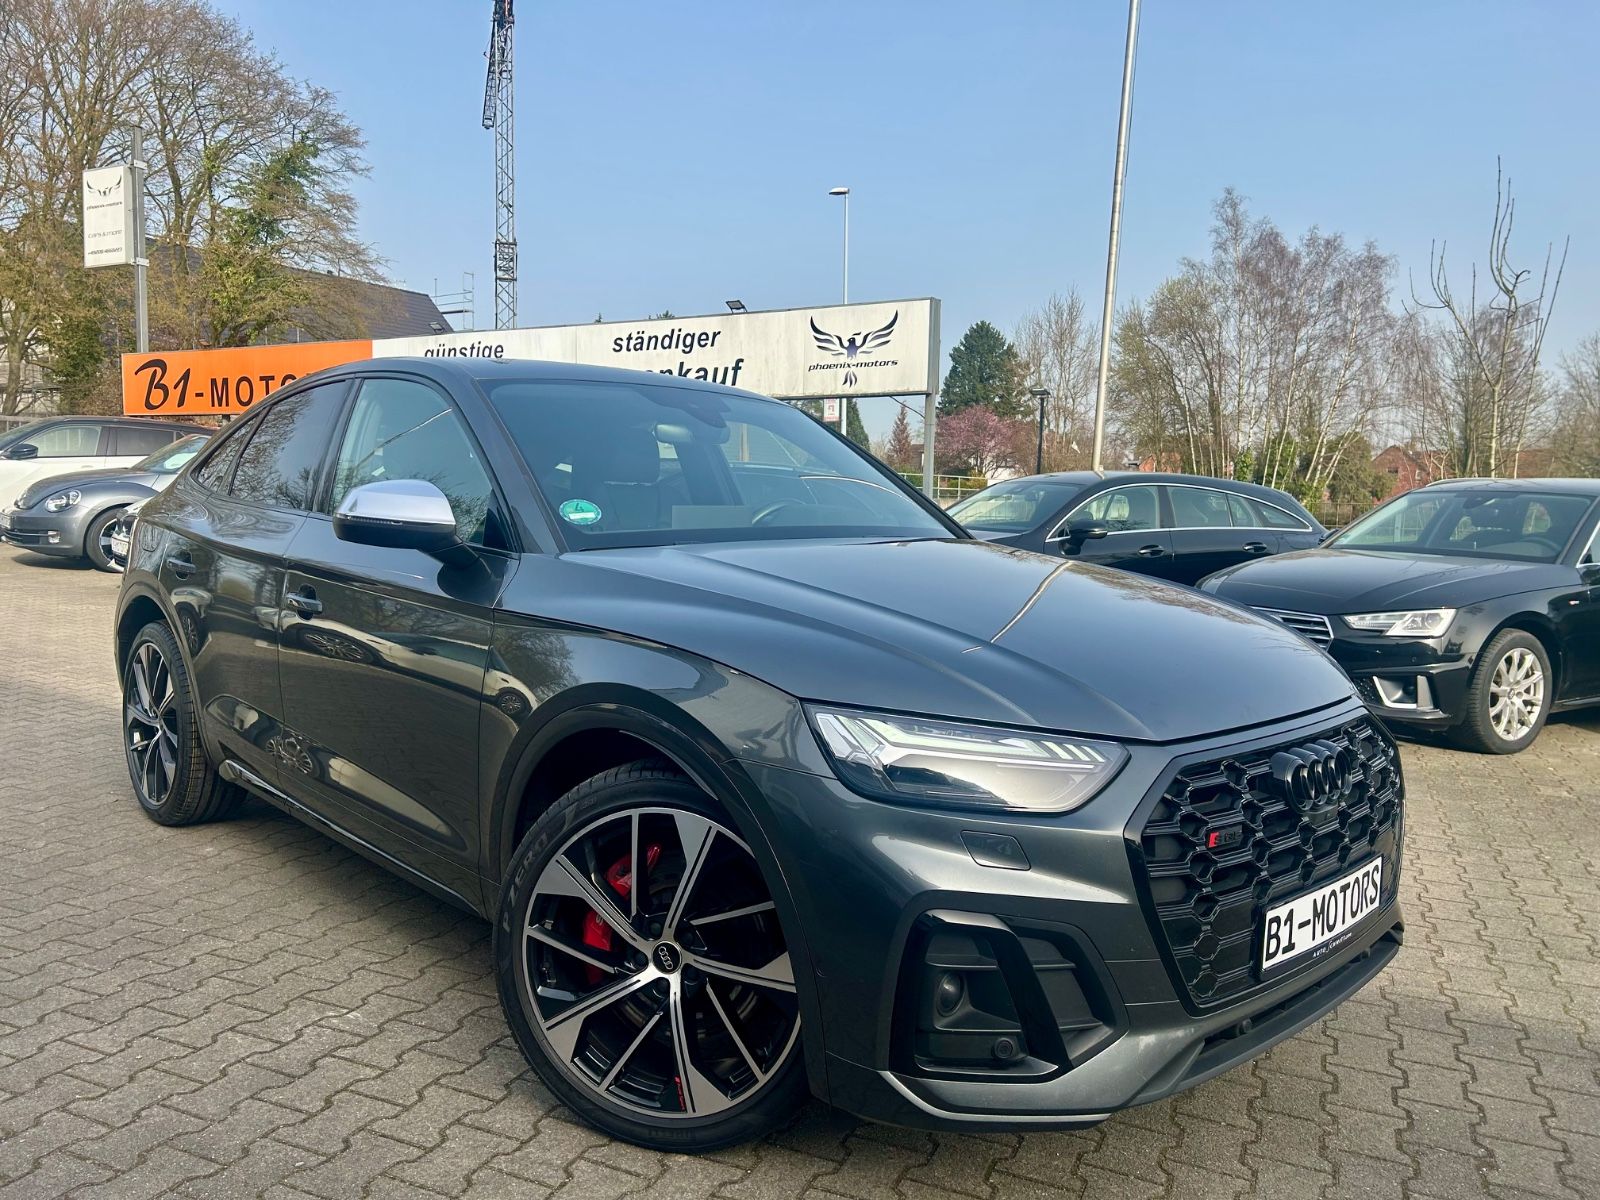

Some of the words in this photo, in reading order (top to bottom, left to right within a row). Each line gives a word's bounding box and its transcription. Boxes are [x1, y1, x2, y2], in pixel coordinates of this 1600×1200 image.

[612, 328, 721, 354] ständiger
[808, 360, 899, 372] phoenix-motors
[1265, 864, 1379, 962] B1-MOTORS
